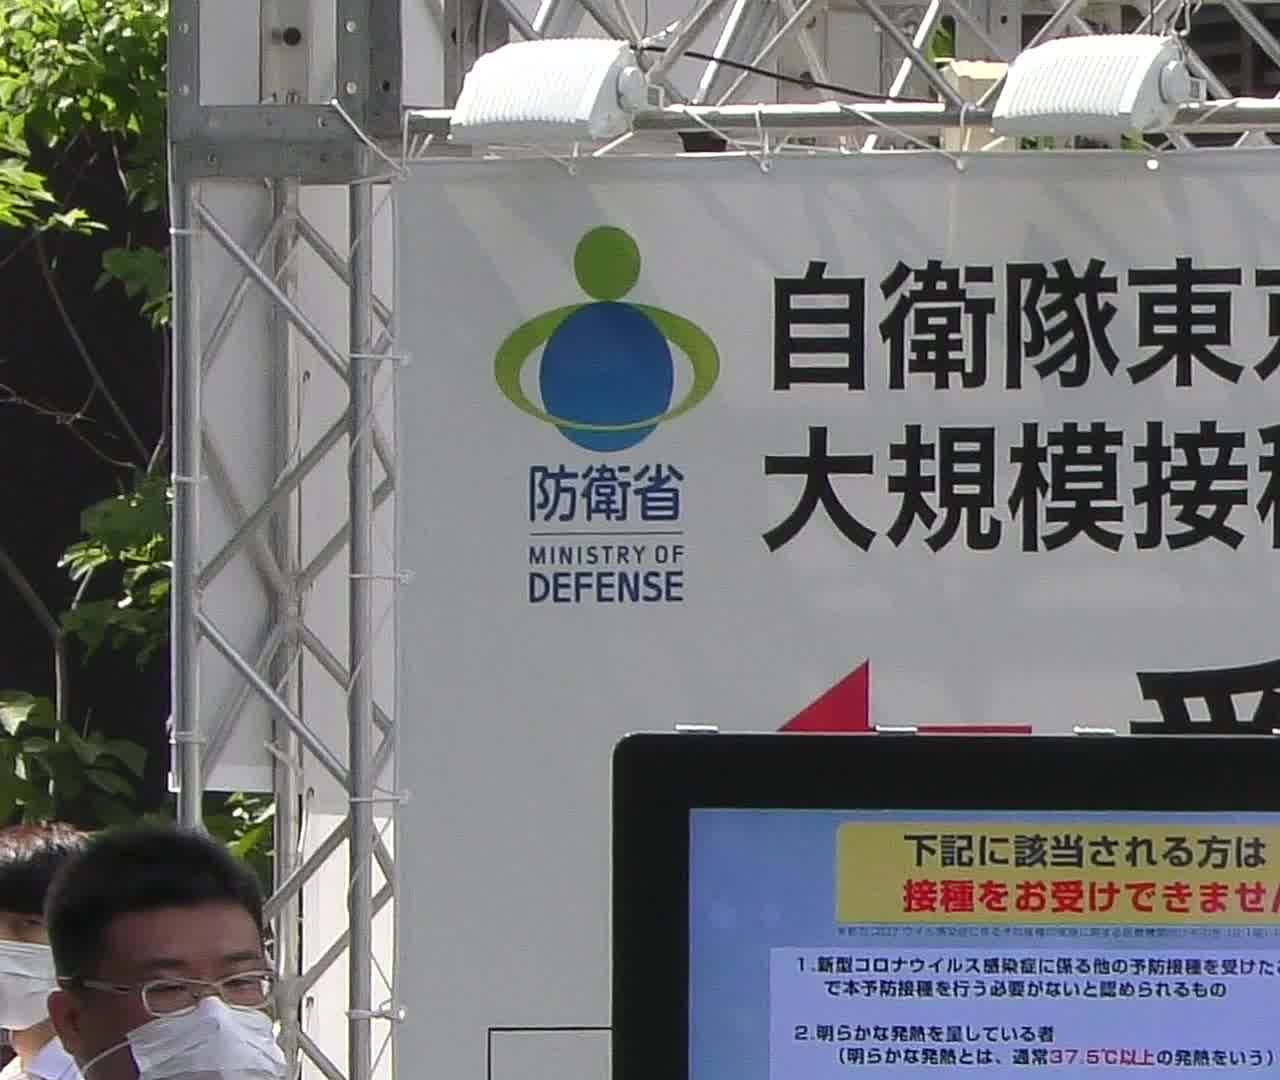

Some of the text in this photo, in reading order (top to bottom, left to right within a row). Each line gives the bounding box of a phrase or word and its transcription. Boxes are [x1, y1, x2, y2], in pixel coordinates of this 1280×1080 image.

[529, 463, 684, 523] 防衛省
[529, 544, 685, 565] MINISTRY OF
[529, 570, 684, 604] DEFENSE
[903, 833, 1267, 870] 下記に該当される方は
